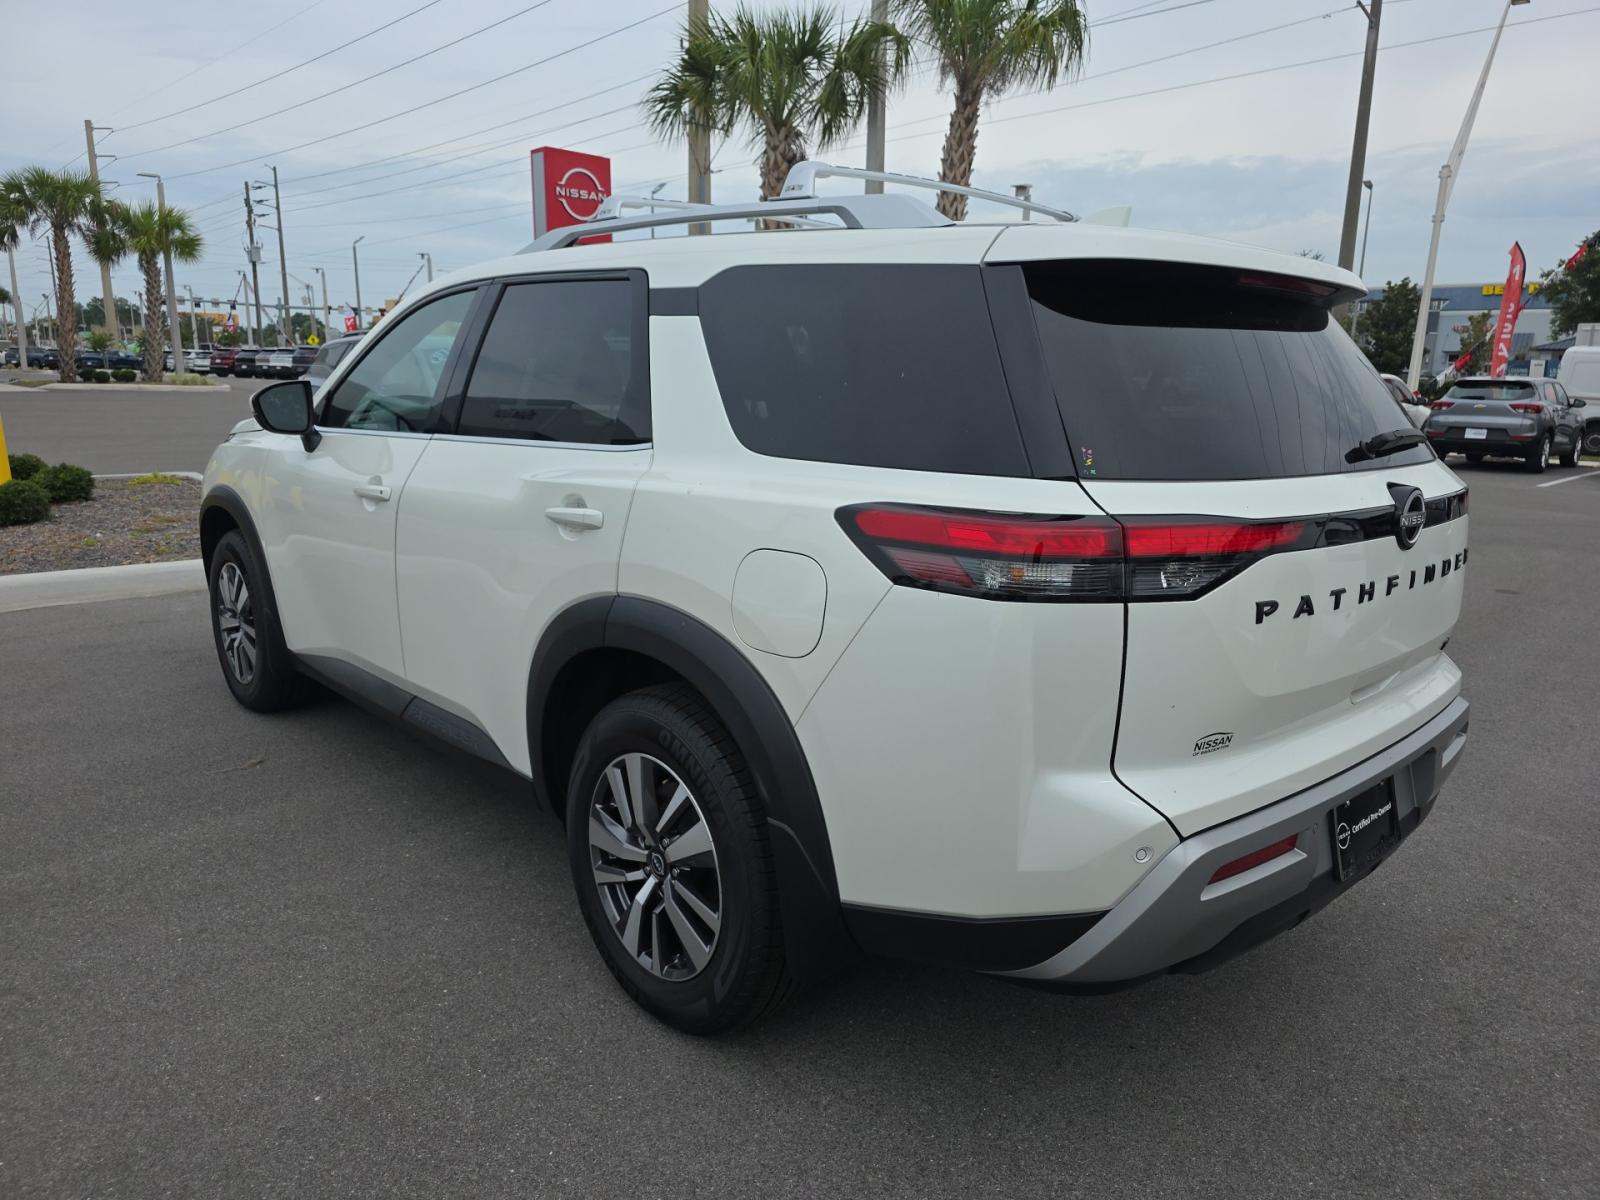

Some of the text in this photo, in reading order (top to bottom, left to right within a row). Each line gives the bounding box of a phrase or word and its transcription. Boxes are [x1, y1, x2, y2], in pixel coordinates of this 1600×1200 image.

[555, 186, 606, 202] NISSAN
[1401, 515, 1424, 526] NISS
[1193, 735, 1233, 751] NISSAN
